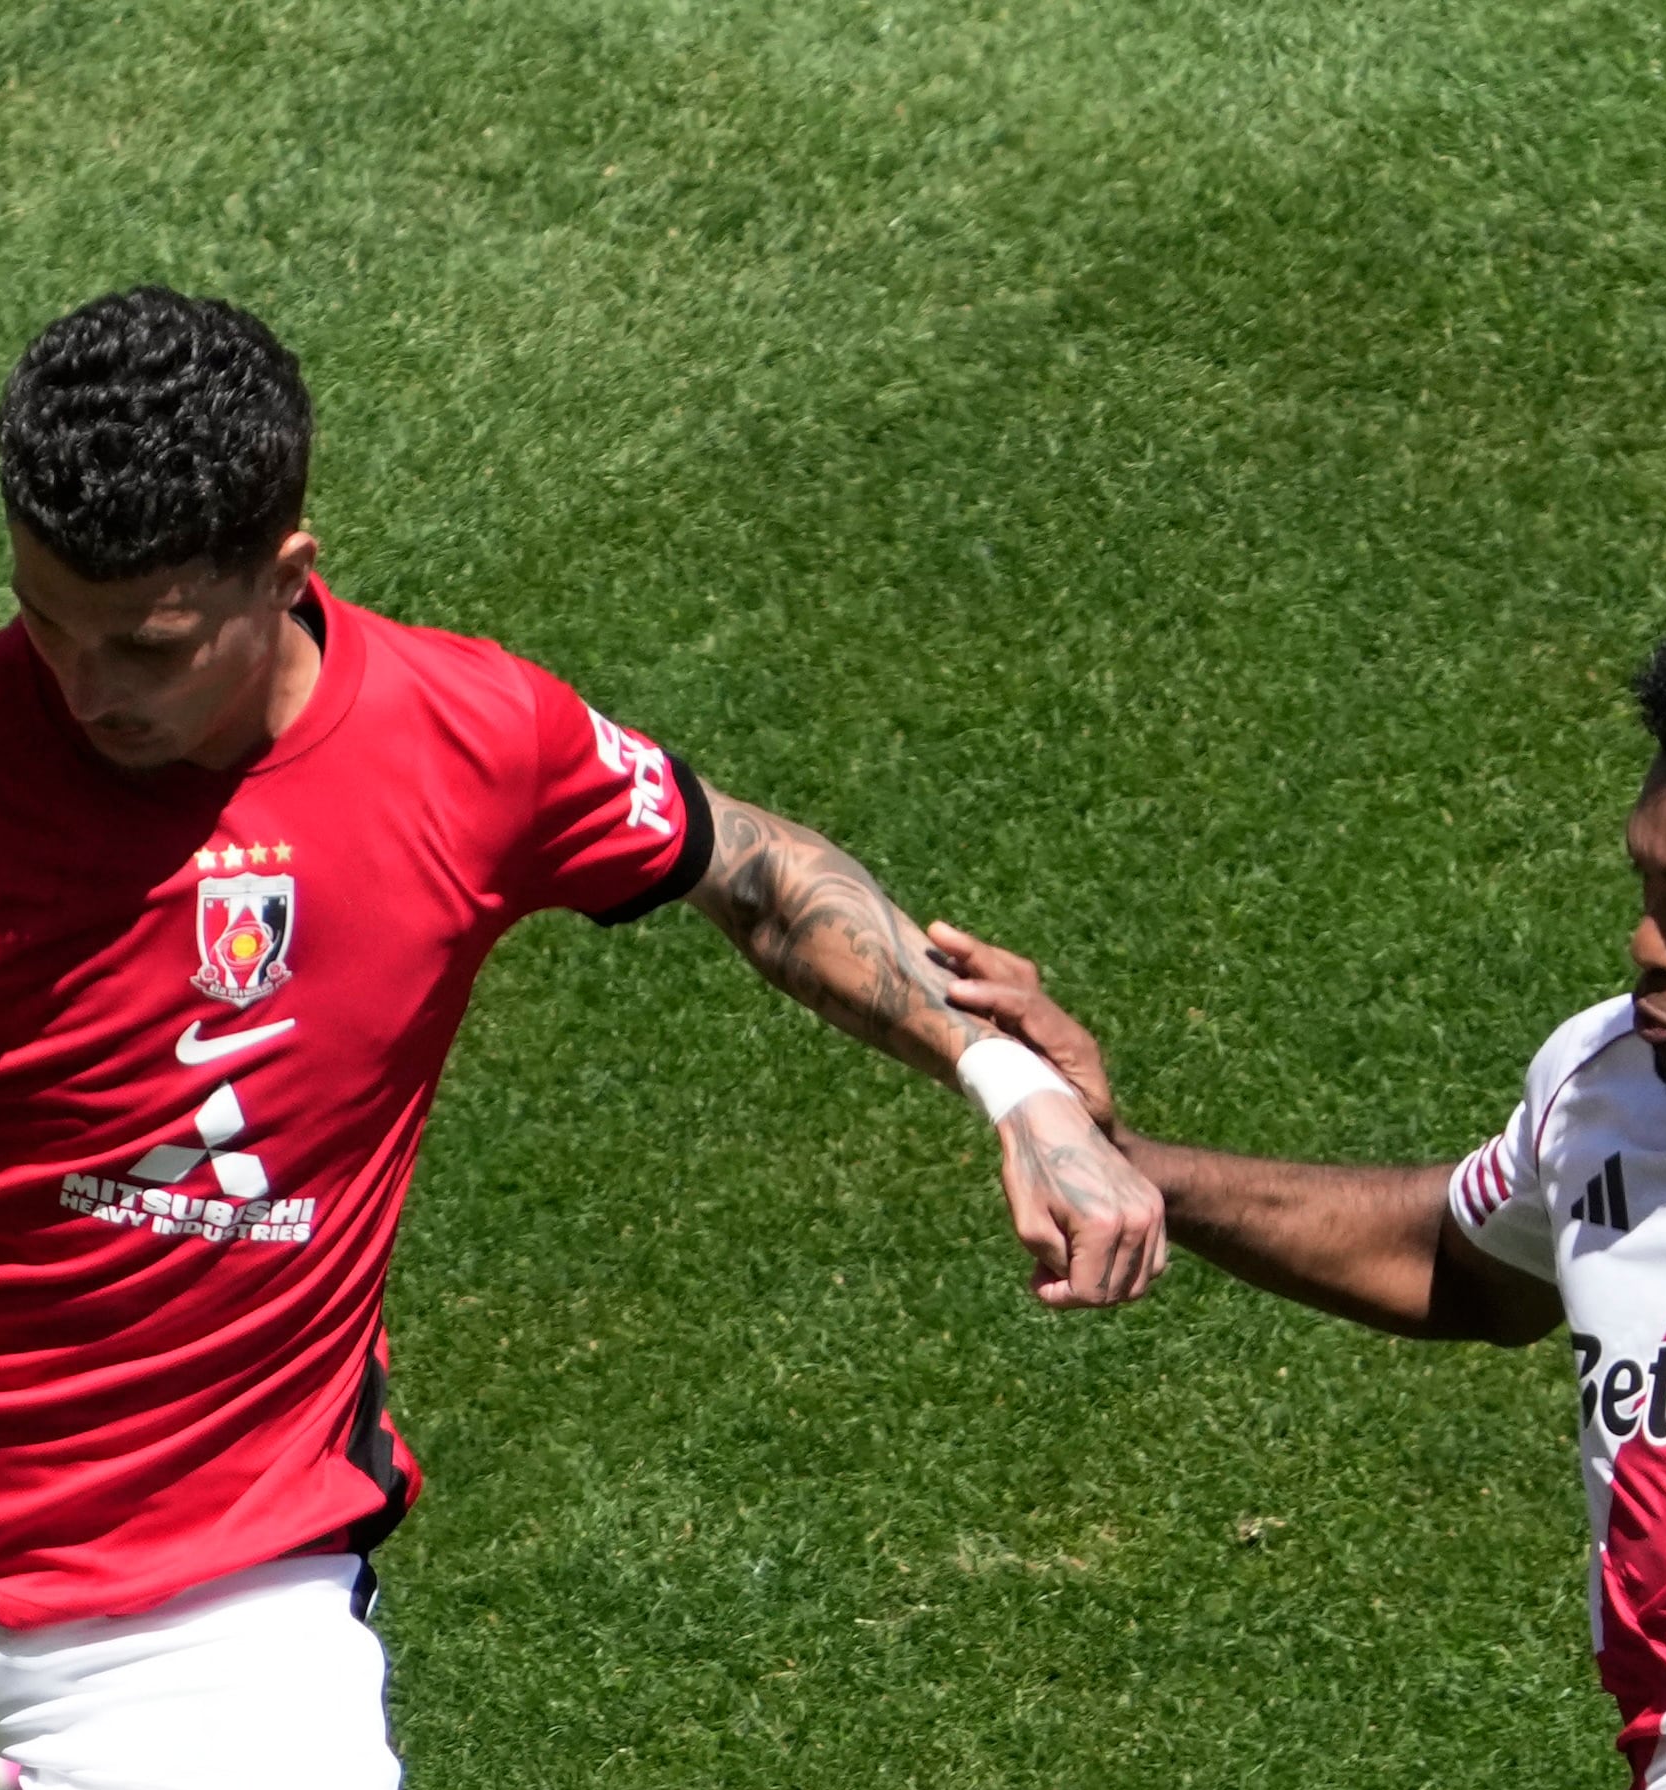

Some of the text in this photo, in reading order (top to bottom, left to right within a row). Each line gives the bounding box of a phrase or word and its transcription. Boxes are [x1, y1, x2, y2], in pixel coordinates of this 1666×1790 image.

[59, 1191, 311, 1242] HEAVY INDUSTRIES
[62, 1173, 315, 1226] MITSUBISHI
